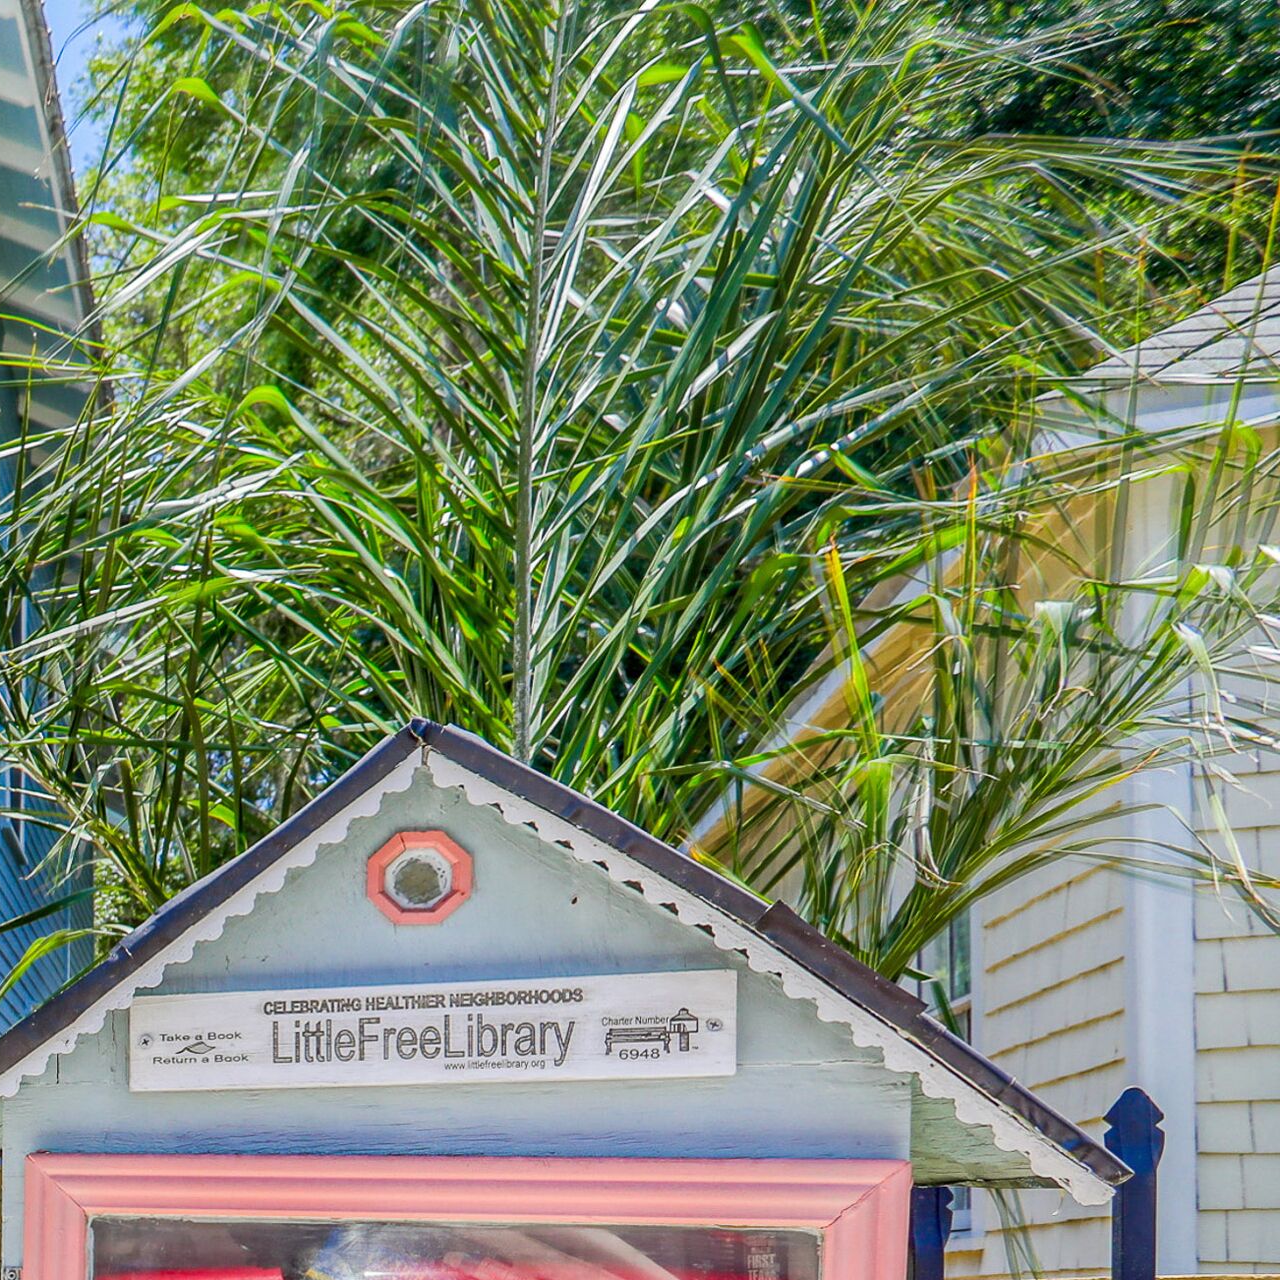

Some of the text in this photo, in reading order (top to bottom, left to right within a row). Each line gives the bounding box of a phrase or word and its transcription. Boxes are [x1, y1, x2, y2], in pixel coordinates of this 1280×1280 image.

[263, 988, 584, 1015] CELEBRATING HEALTHIER NEIGHBORHOODS
[601, 1015, 670, 1027] Charter Number
[159, 1033, 191, 1042] Take
[207, 1031, 243, 1041] Book
[272, 1013, 575, 1066] LittleFreeLibrary
[152, 1053, 249, 1065] Return a Book
[618, 1048, 661, 1060] 6948
[443, 1059, 546, 1071] www.littlefreelibrary.org
[747, 1253, 777, 1269] FIRST
